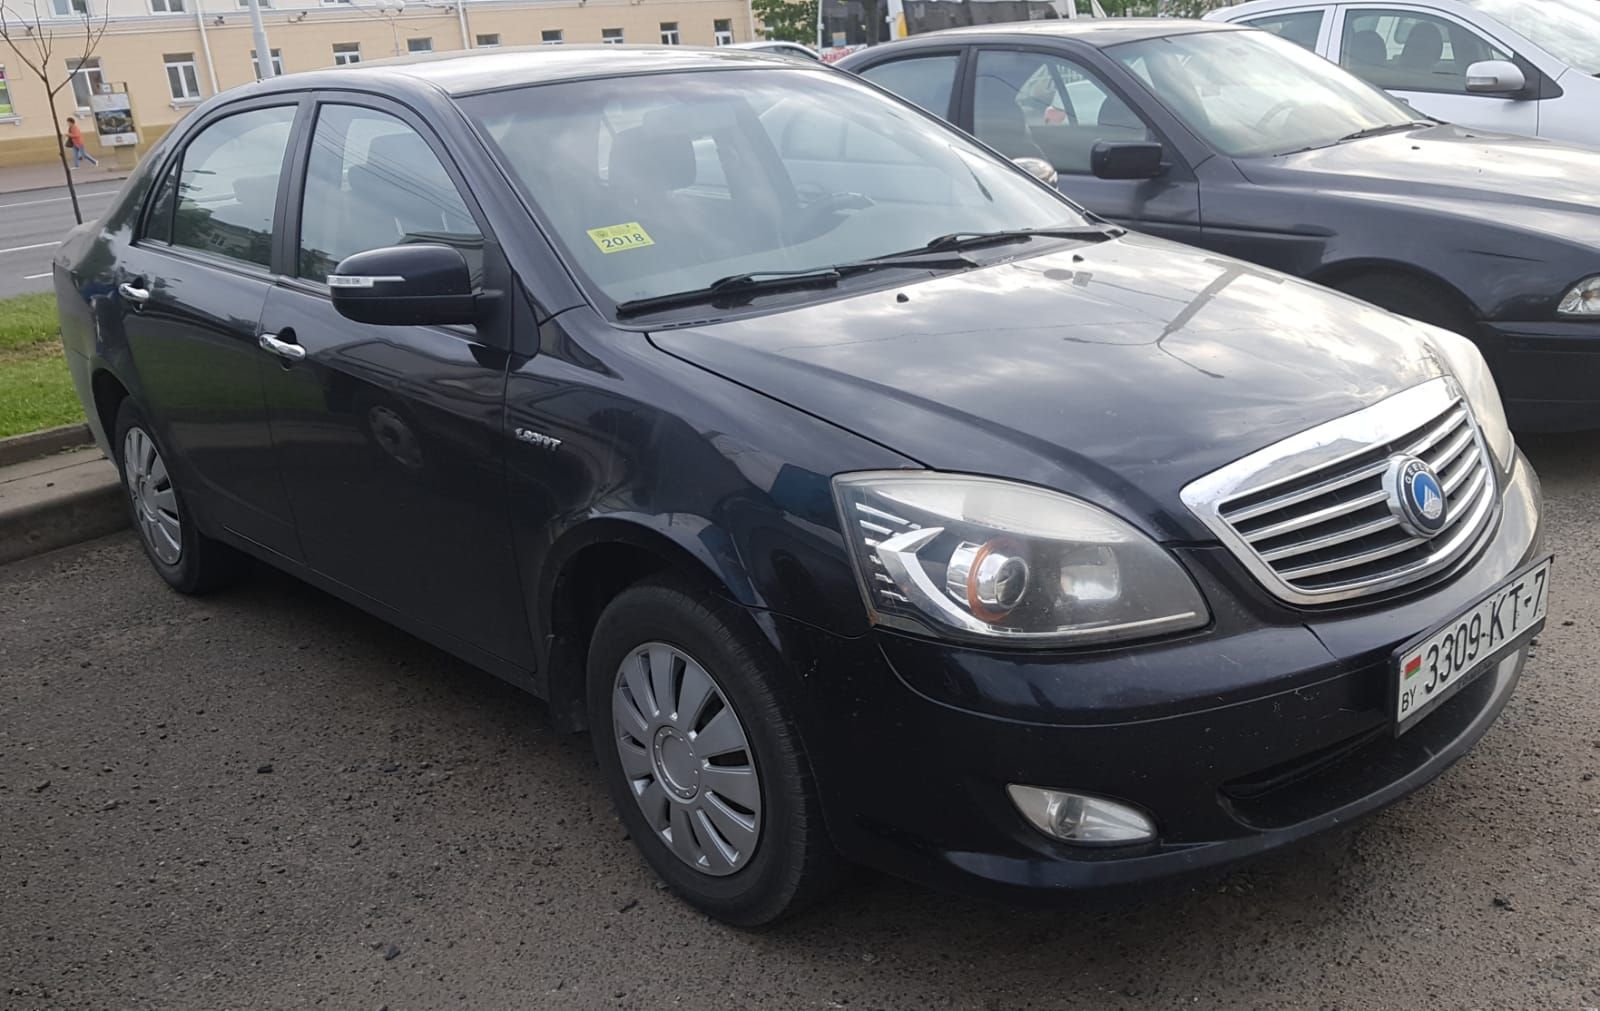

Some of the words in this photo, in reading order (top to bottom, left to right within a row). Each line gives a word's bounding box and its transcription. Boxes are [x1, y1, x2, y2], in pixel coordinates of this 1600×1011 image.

[601, 232, 645, 248] 2018
[1424, 568, 1547, 695] 3309-KT-7
[1401, 686, 1417, 713] BY
